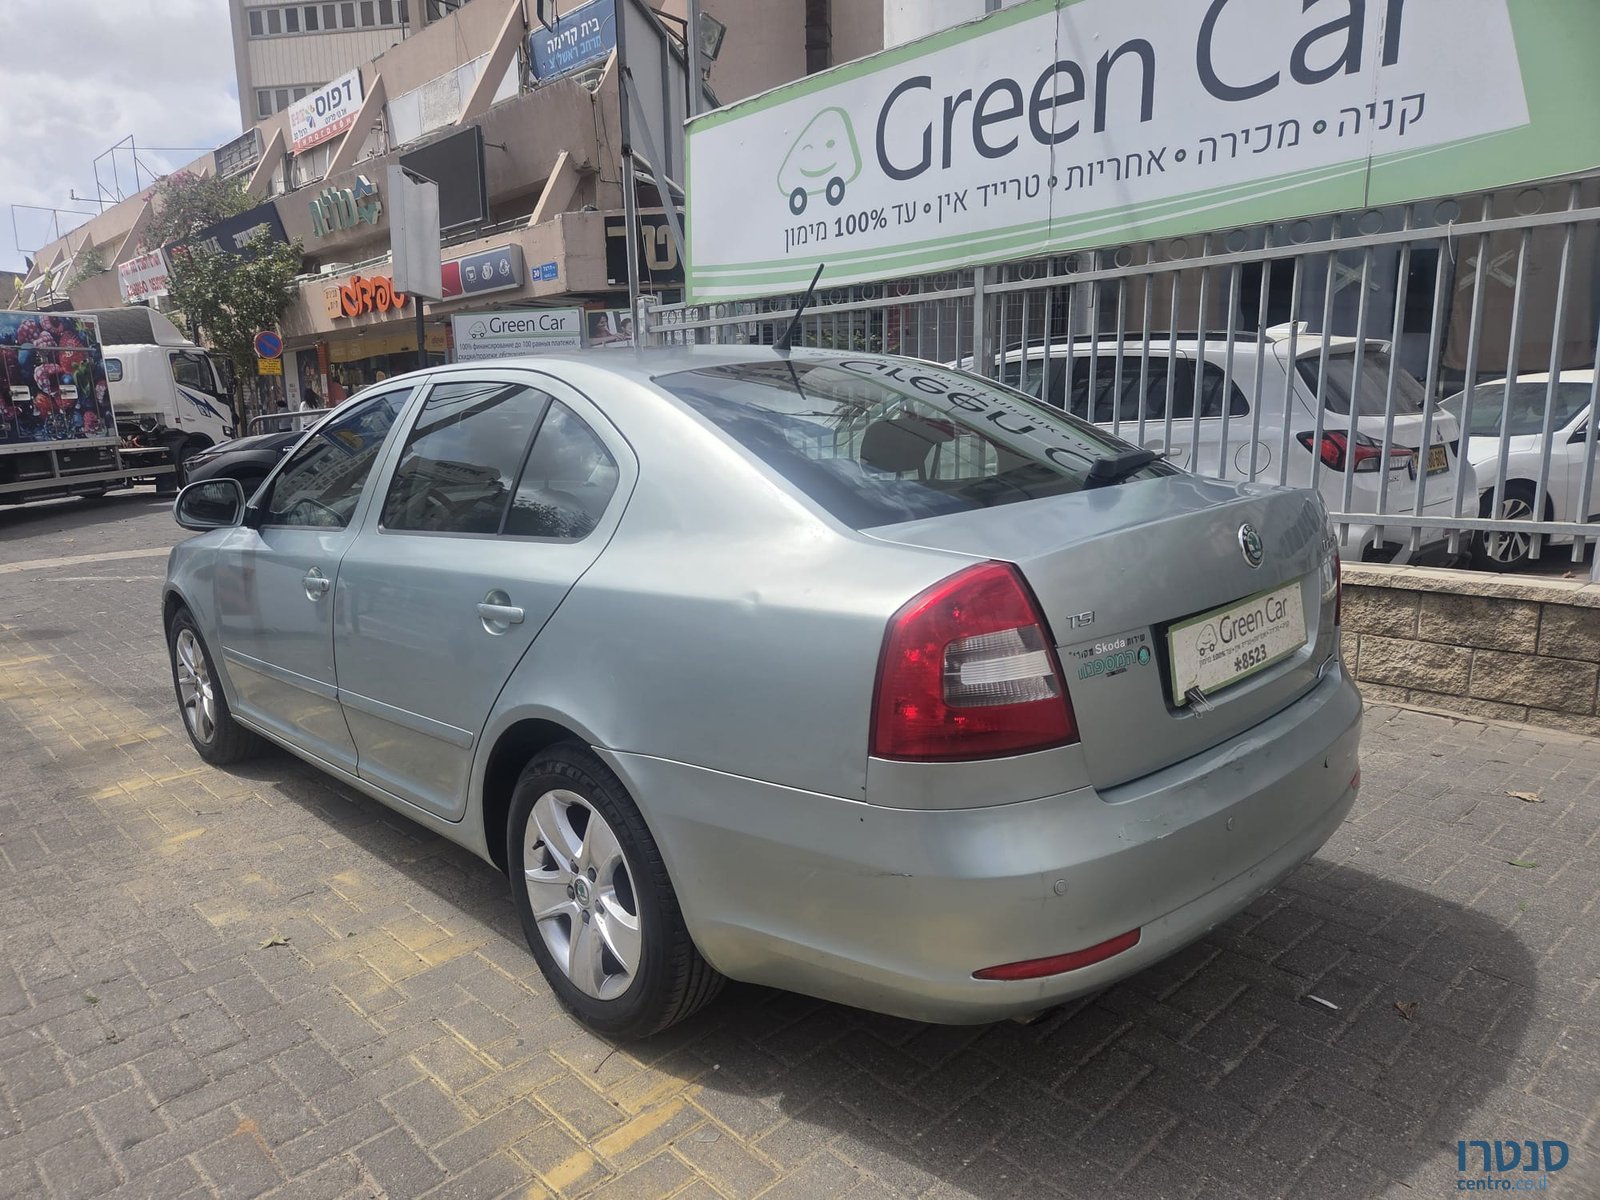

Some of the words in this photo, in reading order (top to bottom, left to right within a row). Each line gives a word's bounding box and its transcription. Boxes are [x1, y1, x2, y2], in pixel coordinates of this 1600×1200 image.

[546, 26, 578, 55] קדימה
[581, 17, 600, 38] בית
[314, 79, 352, 117] דפוס
[876, 38, 1155, 181] Green
[1338, 92, 1426, 137] קניה
[1197, 118, 1300, 165] מכירה
[1064, 146, 1167, 191] אחריות
[937, 189, 968, 224] אין
[976, 174, 1040, 208] טרייד
[834, 207, 887, 238] 100%
[891, 200, 917, 225] עד
[784, 220, 828, 254] מימון
[489, 317, 536, 334] Green
[538, 314, 566, 331] Car
[1066, 611, 1095, 629] TSI
[1219, 609, 1264, 644] Green
[1265, 597, 1288, 623] Car
[1094, 638, 1126, 655] Skoda
